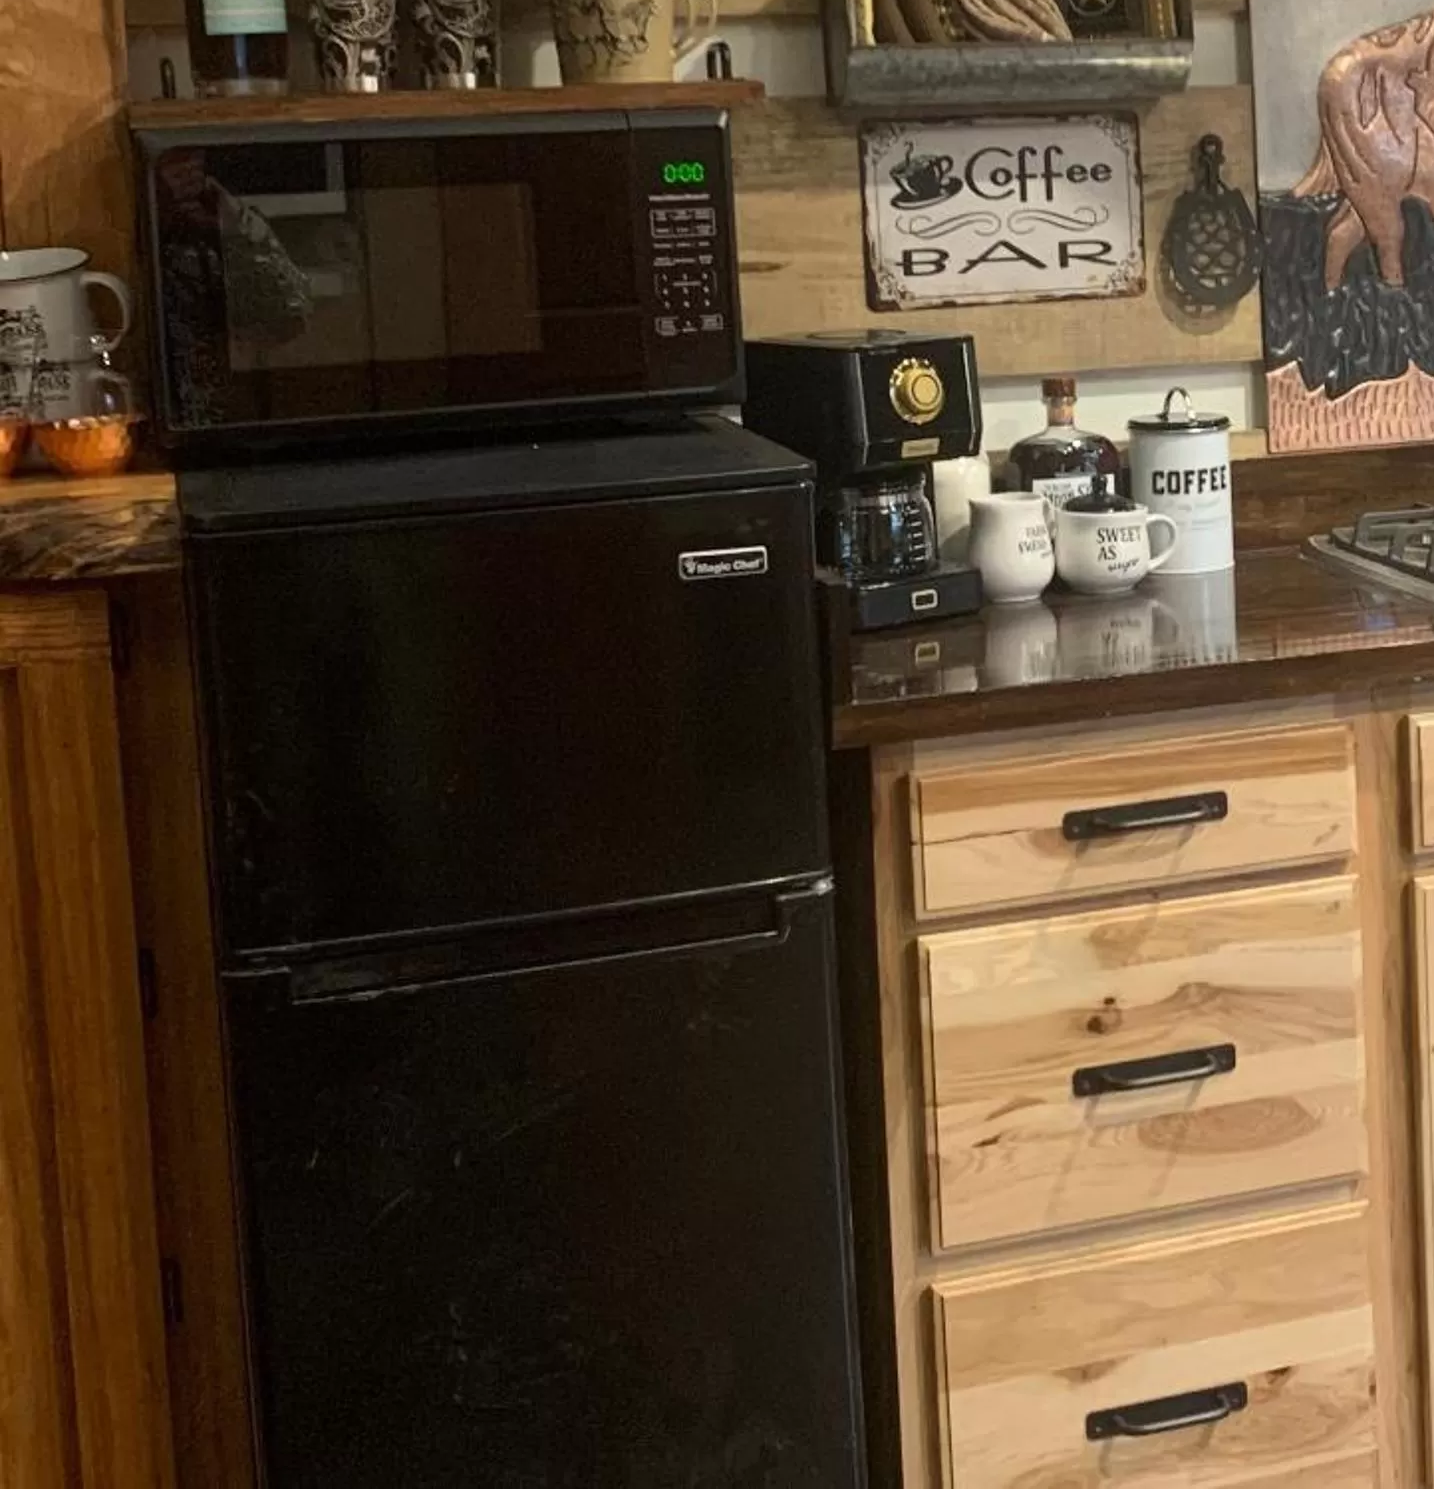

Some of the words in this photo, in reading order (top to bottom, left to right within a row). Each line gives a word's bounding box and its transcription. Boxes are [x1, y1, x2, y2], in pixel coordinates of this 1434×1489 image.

[964, 145, 1112, 203] Coffee
[896, 239, 1117, 277] BAR
[1151, 464, 1228, 496] COFFEE
[1096, 525, 1142, 544] SWEET
[1098, 545, 1118, 562] AS
